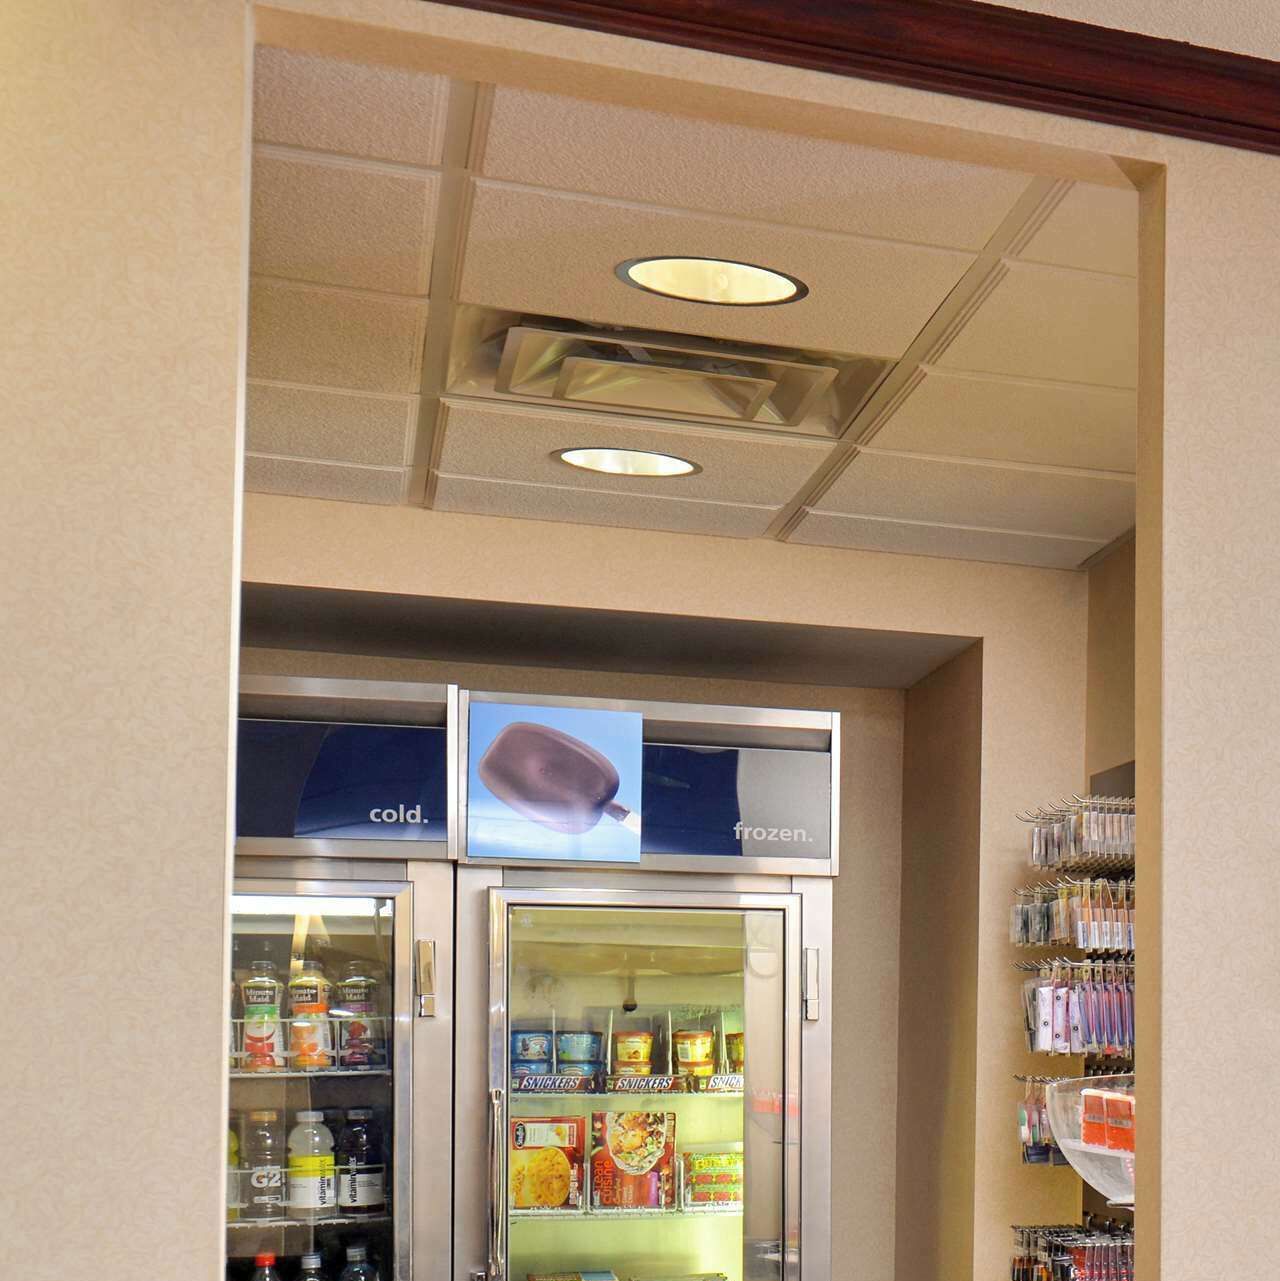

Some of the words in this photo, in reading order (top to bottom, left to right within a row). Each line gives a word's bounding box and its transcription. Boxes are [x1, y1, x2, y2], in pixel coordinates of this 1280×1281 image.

[369, 804, 430, 825] cold.
[733, 821, 814, 843] frozen.
[523, 1076, 581, 1090] SNICKERS
[617, 1076, 674, 1090] SNICKERS
